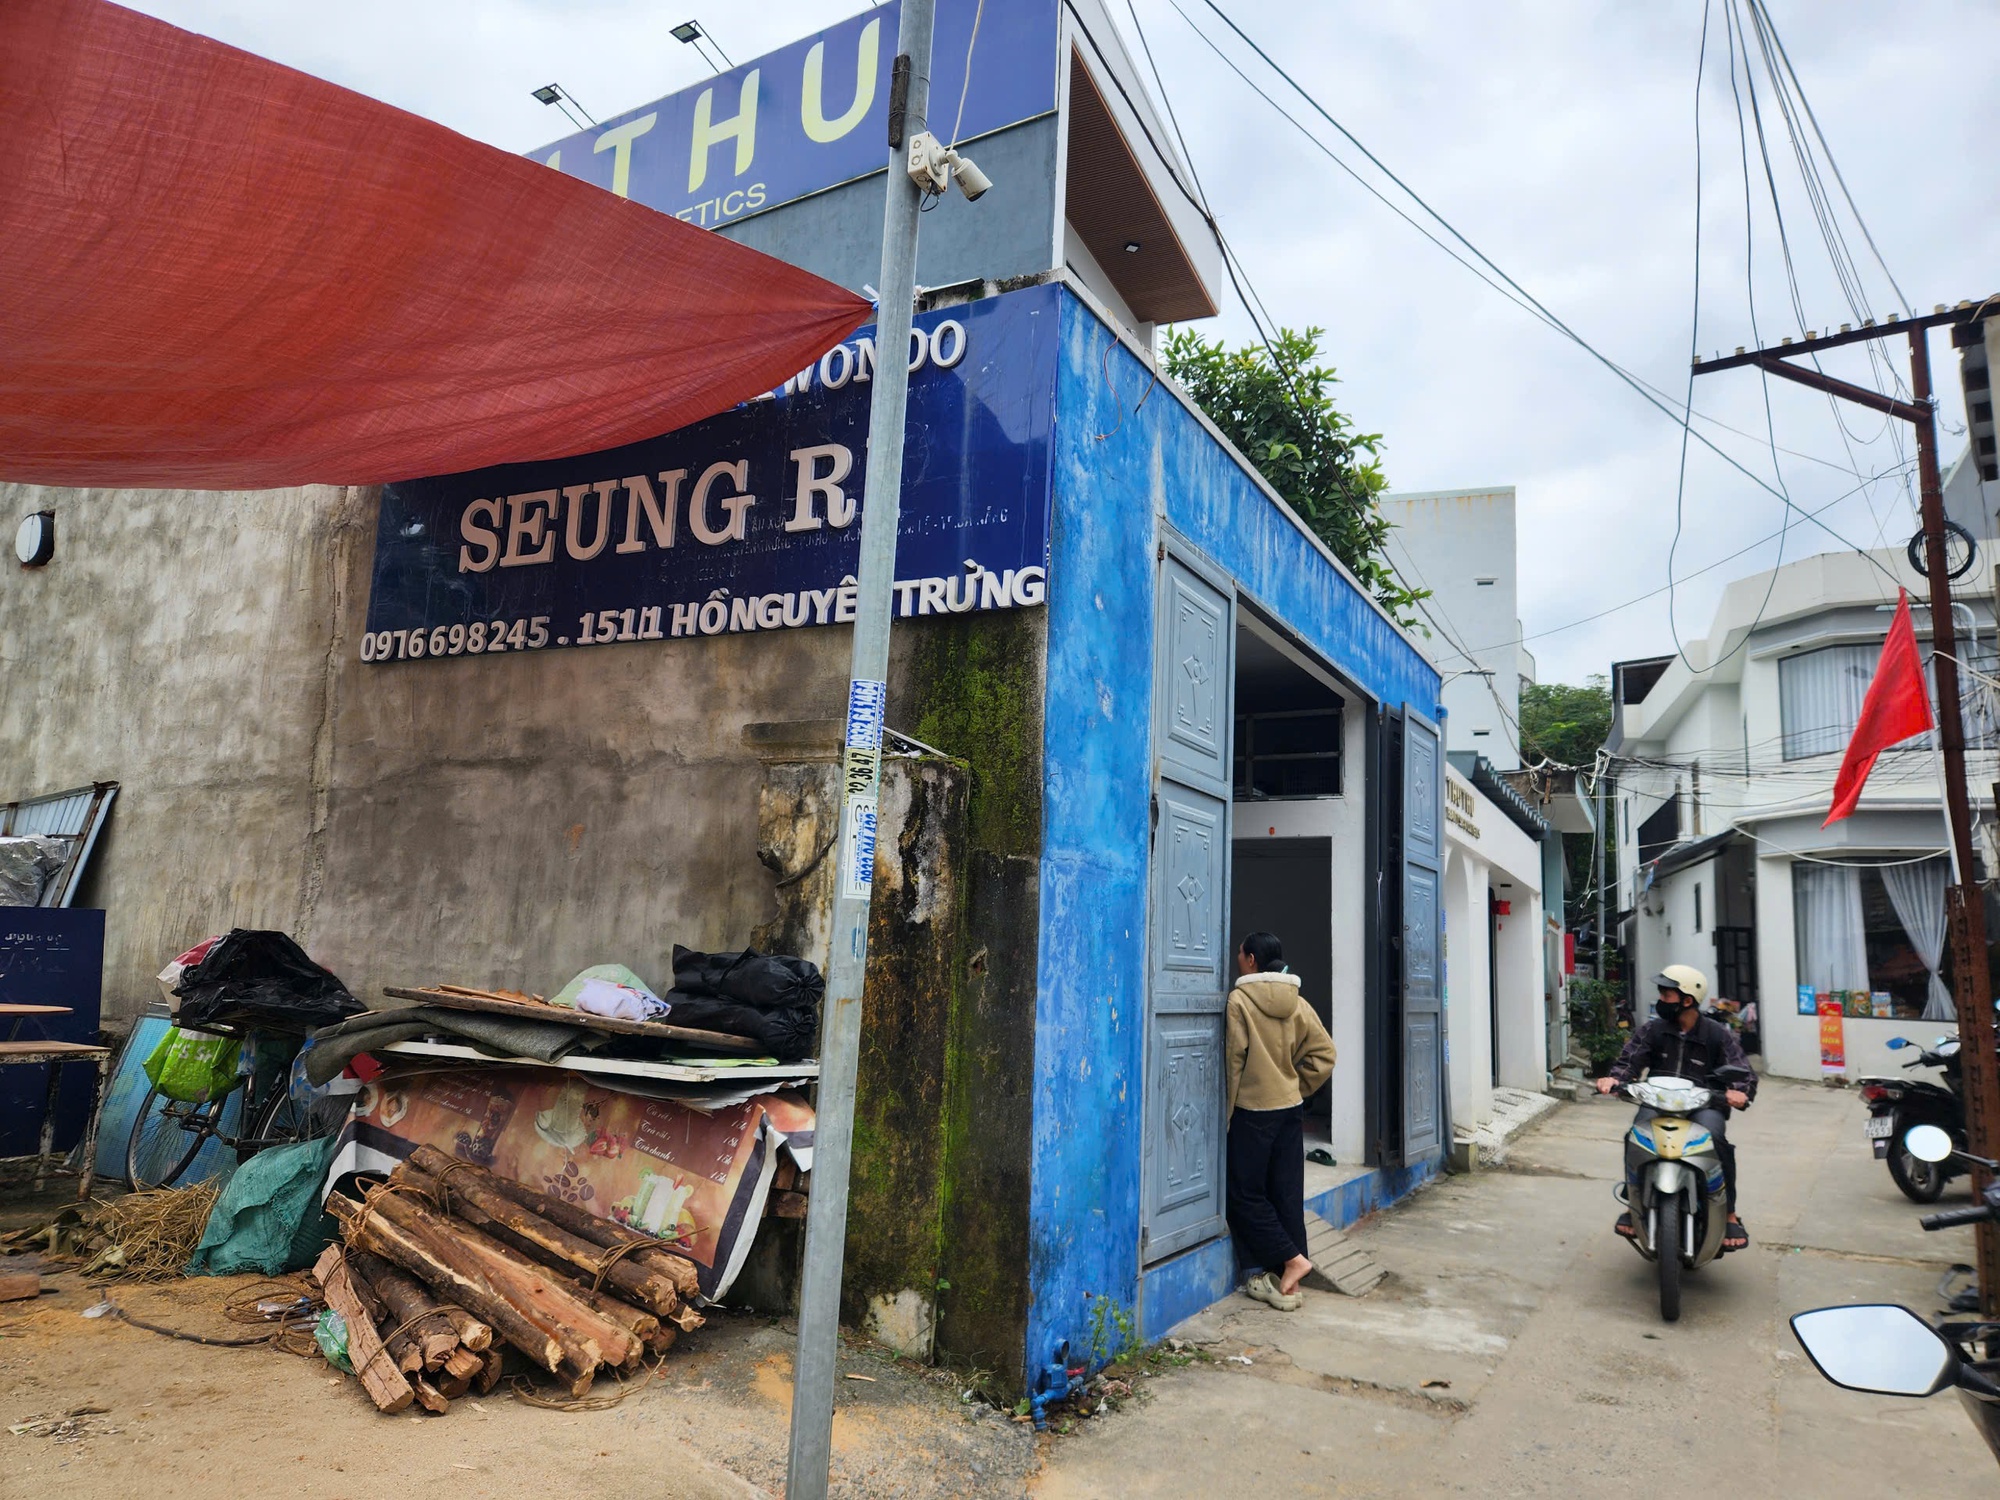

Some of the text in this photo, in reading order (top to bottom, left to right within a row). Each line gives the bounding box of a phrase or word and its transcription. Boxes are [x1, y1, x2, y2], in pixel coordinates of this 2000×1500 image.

[545, 18, 879, 197] THU
[458, 442, 867, 574] SEUNG R
[893, 558, 1046, 618] TRỪNG
